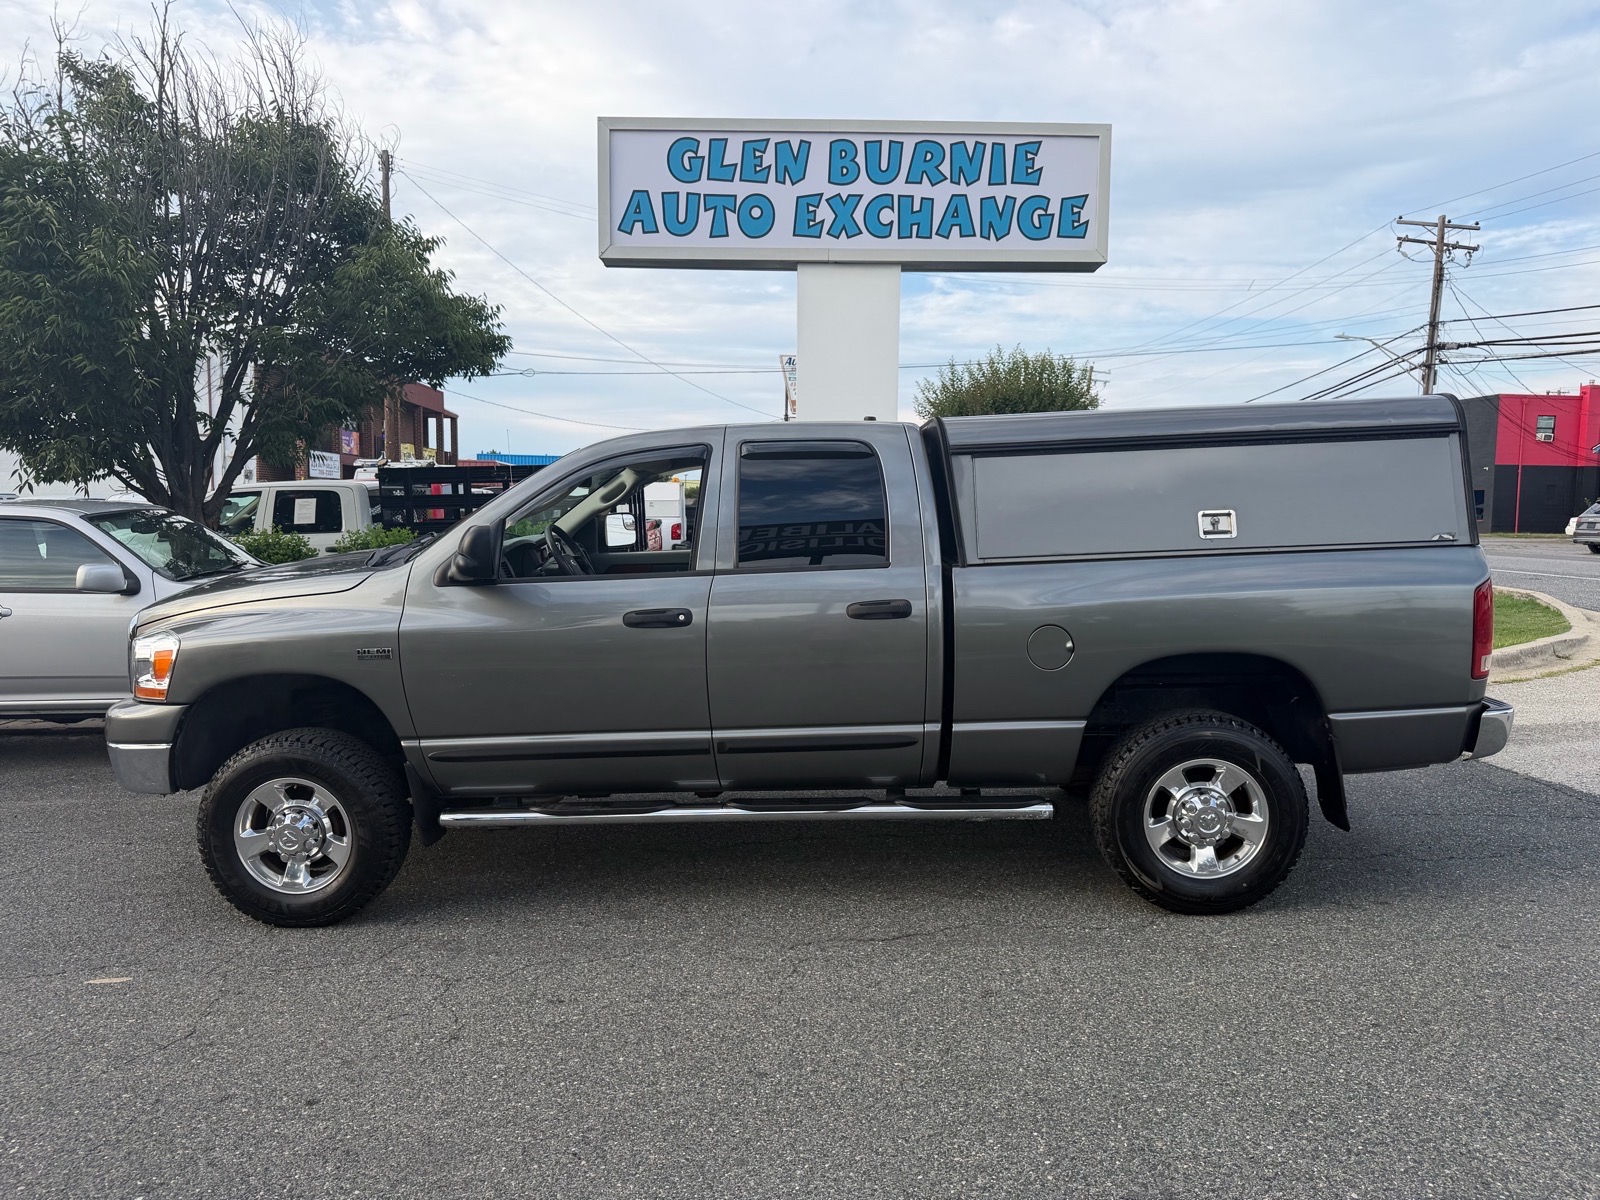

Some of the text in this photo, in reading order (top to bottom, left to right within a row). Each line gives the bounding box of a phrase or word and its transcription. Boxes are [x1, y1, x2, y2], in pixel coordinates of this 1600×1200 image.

[667, 137, 1043, 187] GLEN BURNIE
[618, 190, 1090, 242] AUTO EXCHANGE
[356, 647, 392, 656] HEMI
